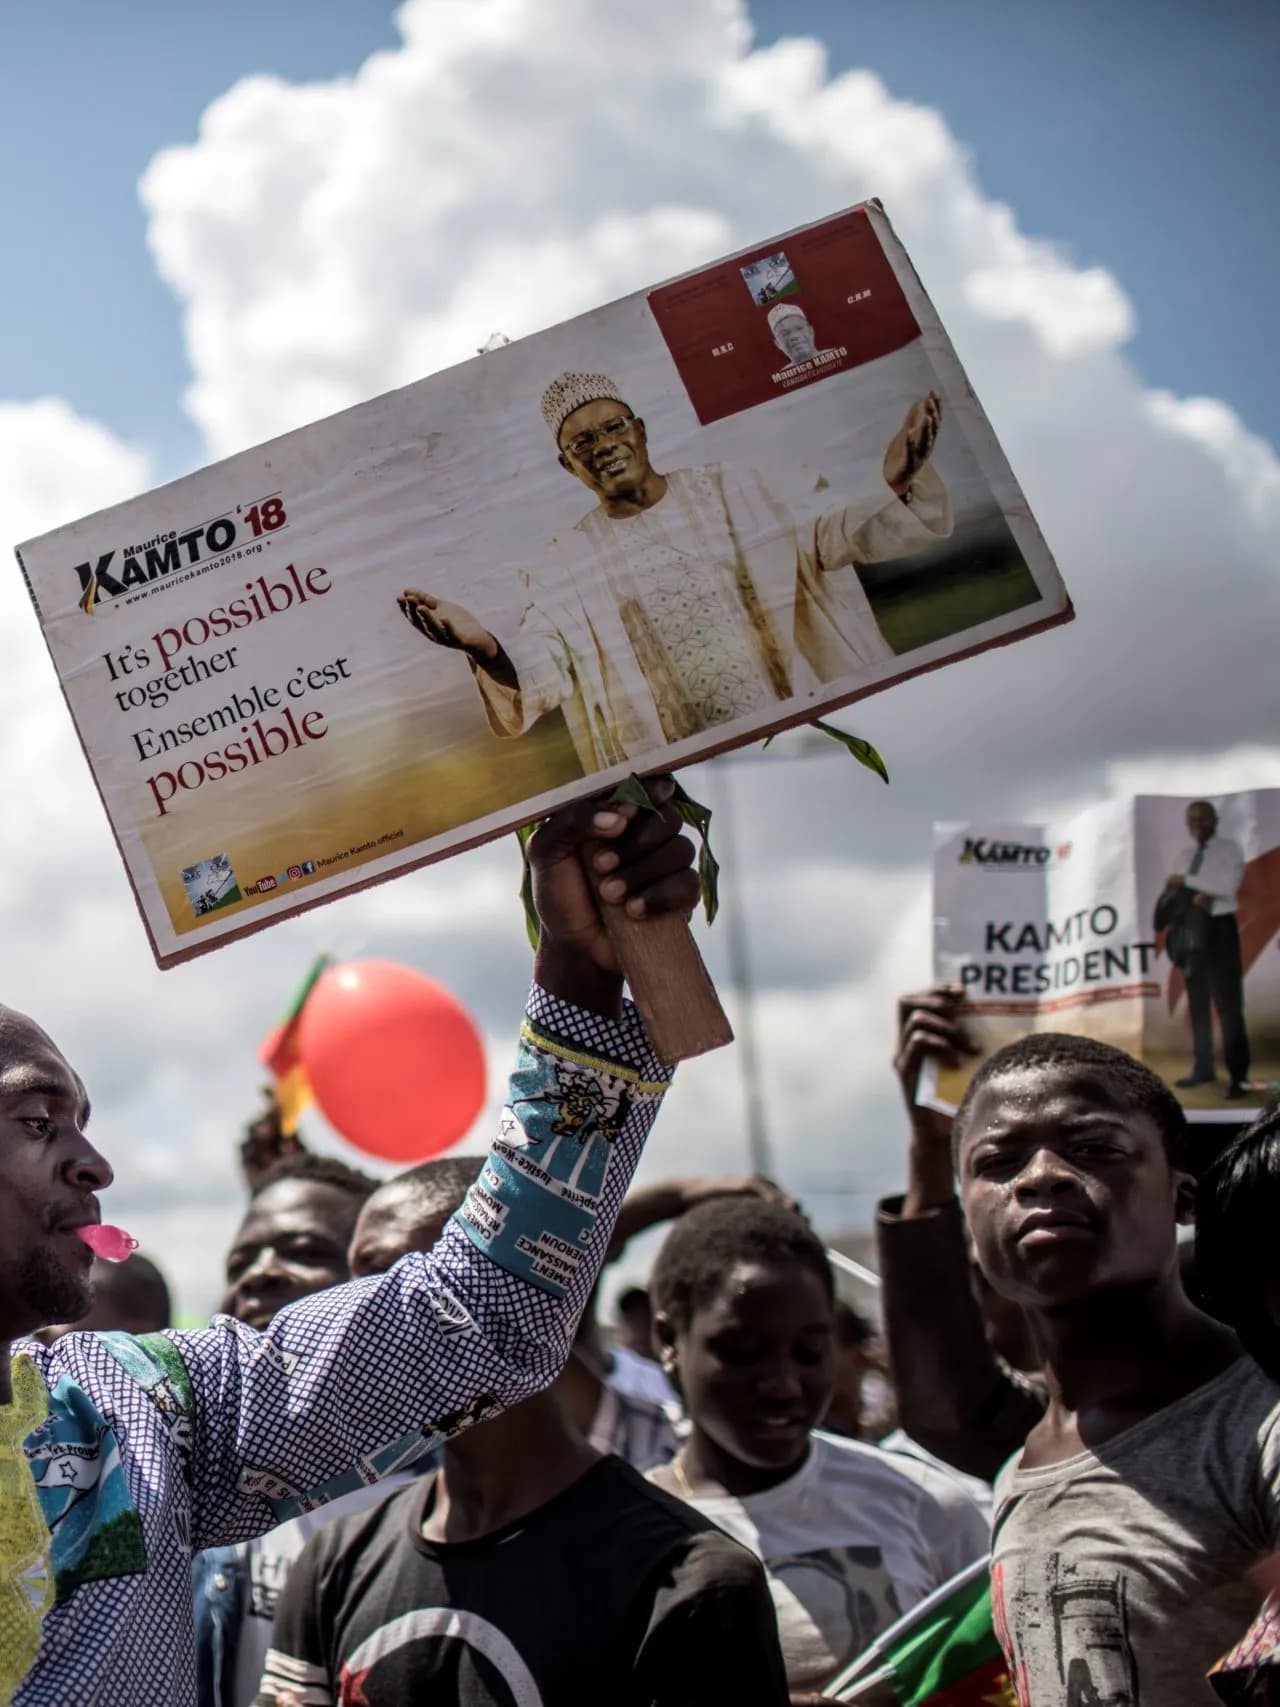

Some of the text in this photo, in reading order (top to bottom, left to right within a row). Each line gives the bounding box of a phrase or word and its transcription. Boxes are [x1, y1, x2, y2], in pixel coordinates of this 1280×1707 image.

[771, 346, 848, 383] Maurice KAMTO
[74, 519, 236, 615] KAMTO
[123, 530, 177, 559] Maurice
[102, 563, 333, 681] It's possible
[114, 645, 238, 712] together
[132, 656, 353, 761] Ensemble c'est
[145, 657, 330, 817] possible
[243, 876, 277, 897] YouTube
[317, 851, 349, 868] Maurice
[349, 839, 377, 857] Kamto
[959, 836, 1051, 865] KAMTO
[985, 904, 1118, 954] KAMTO
[961, 944, 1156, 995] PRESIDENT
